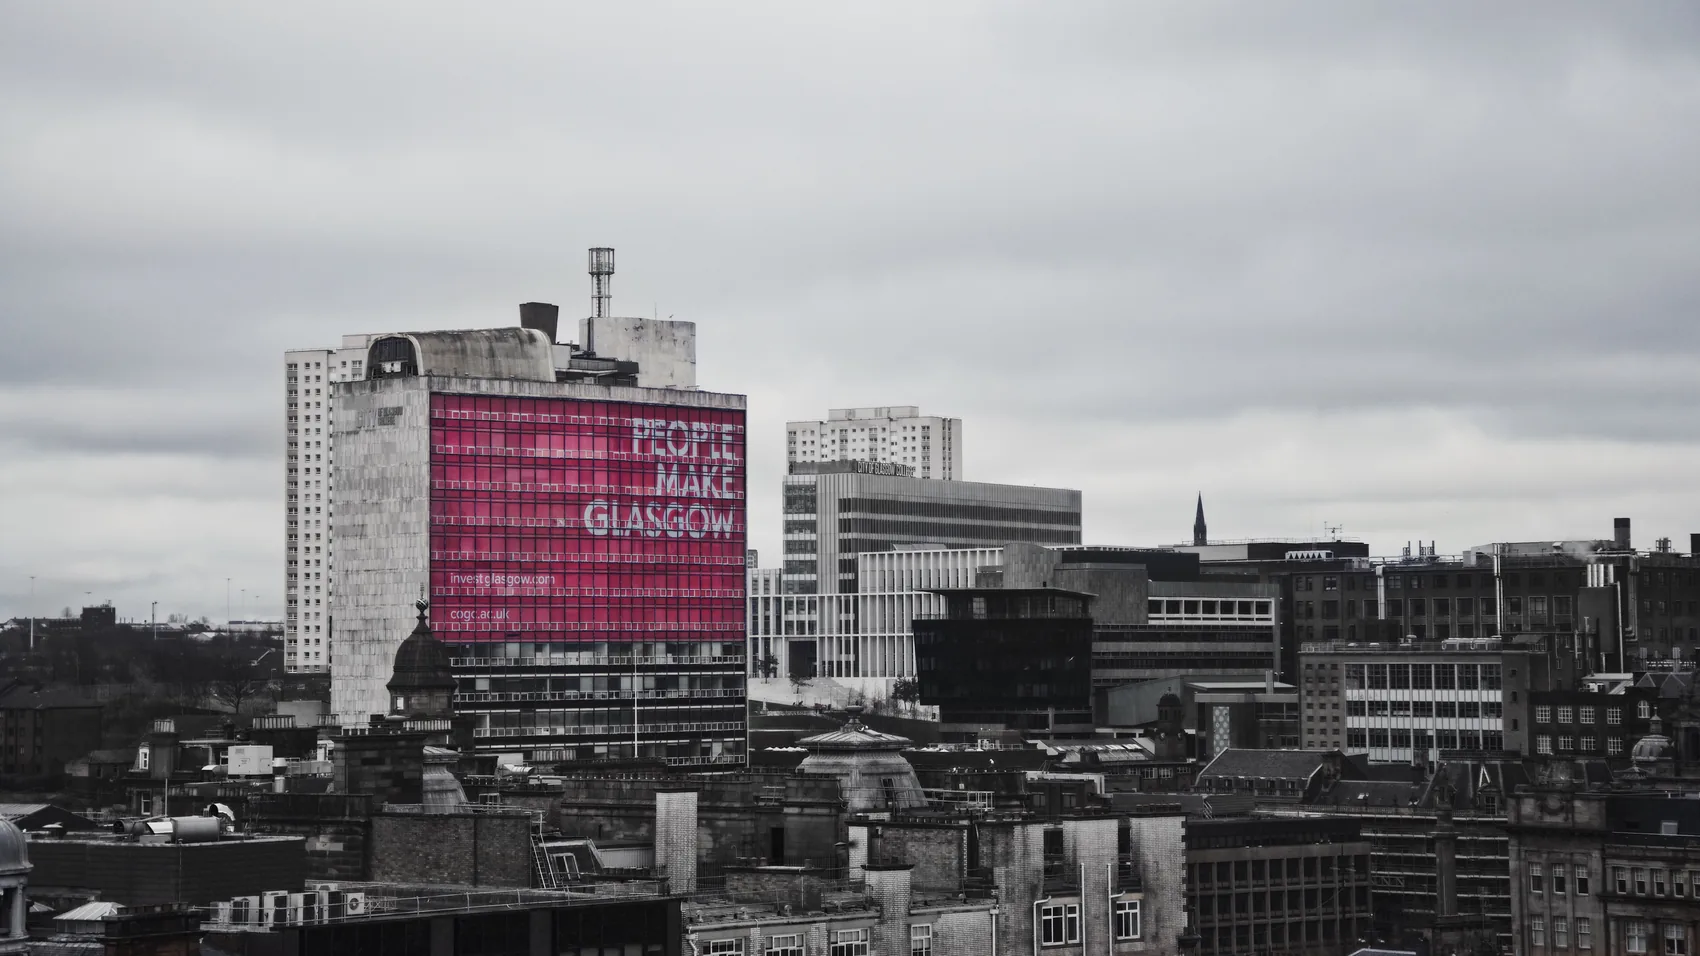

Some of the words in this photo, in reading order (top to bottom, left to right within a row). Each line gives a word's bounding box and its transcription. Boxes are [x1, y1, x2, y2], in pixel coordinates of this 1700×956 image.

[633, 418, 736, 460] PEOPLE
[656, 463, 735, 499] MAKE
[584, 499, 735, 539] GLASGOW
[450, 573, 555, 586] investglasgow.com
[450, 608, 510, 621] cogc.ac.uk
